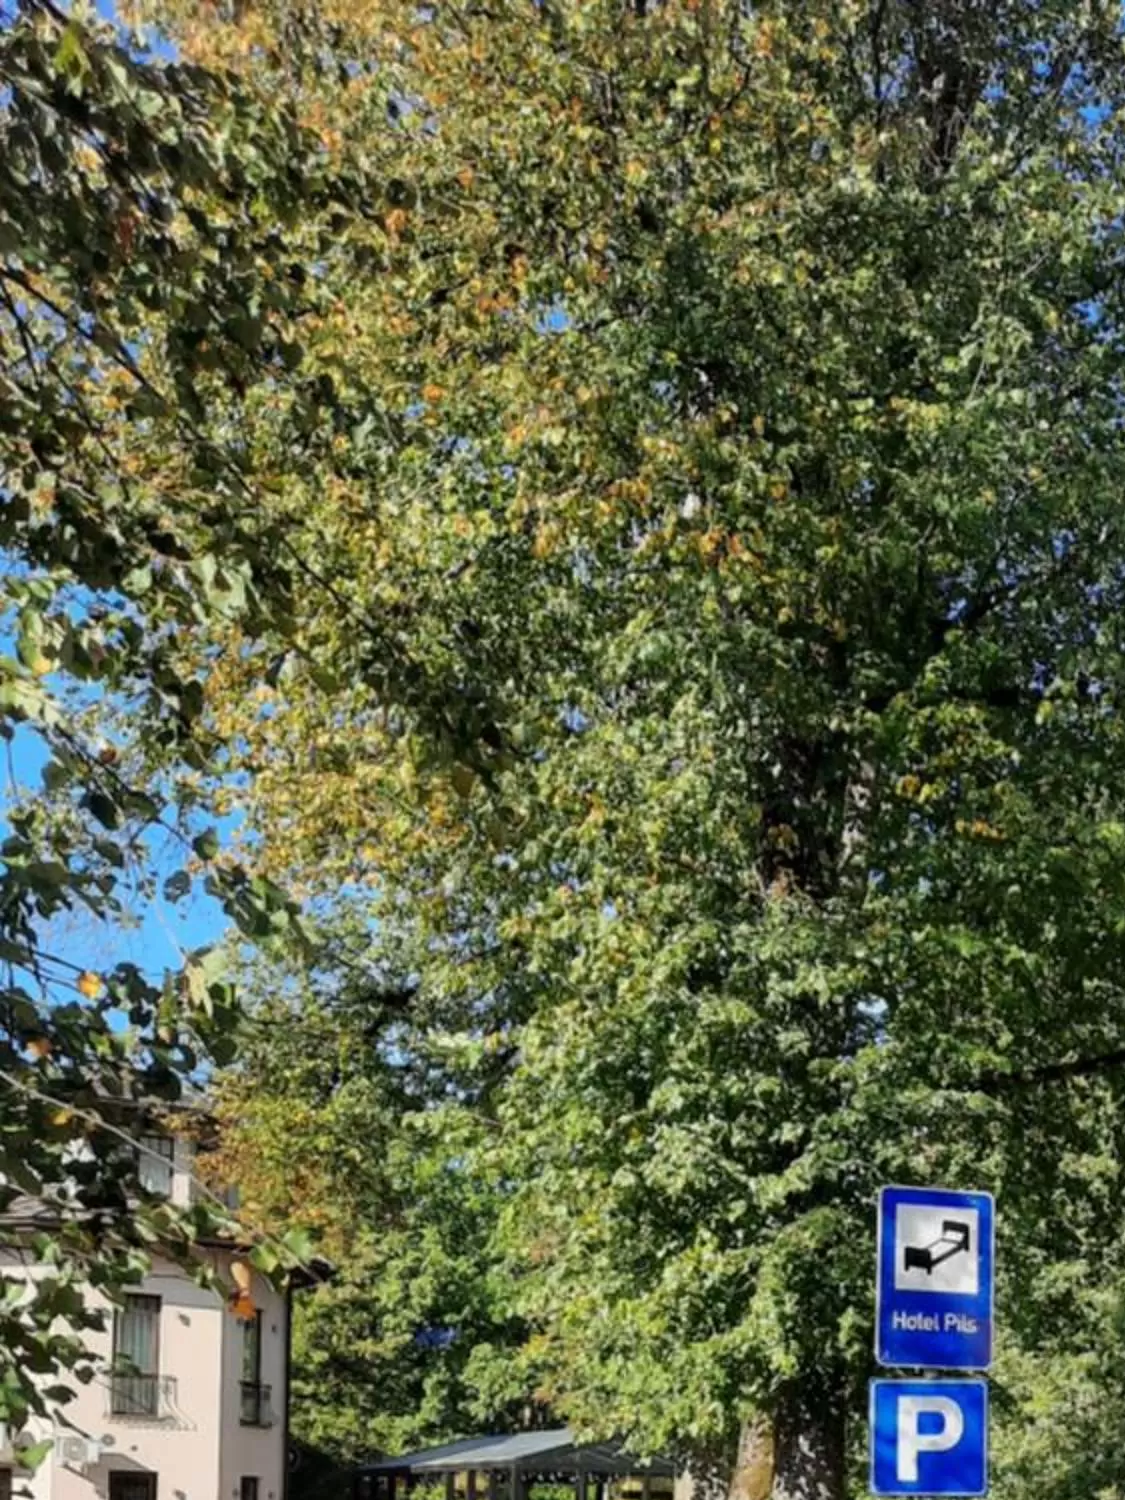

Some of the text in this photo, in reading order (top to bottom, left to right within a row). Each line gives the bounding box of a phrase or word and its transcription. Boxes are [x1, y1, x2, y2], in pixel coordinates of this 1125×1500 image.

[892, 1310, 977, 1333] Hotel Pils
[897, 1395, 964, 1482] P
